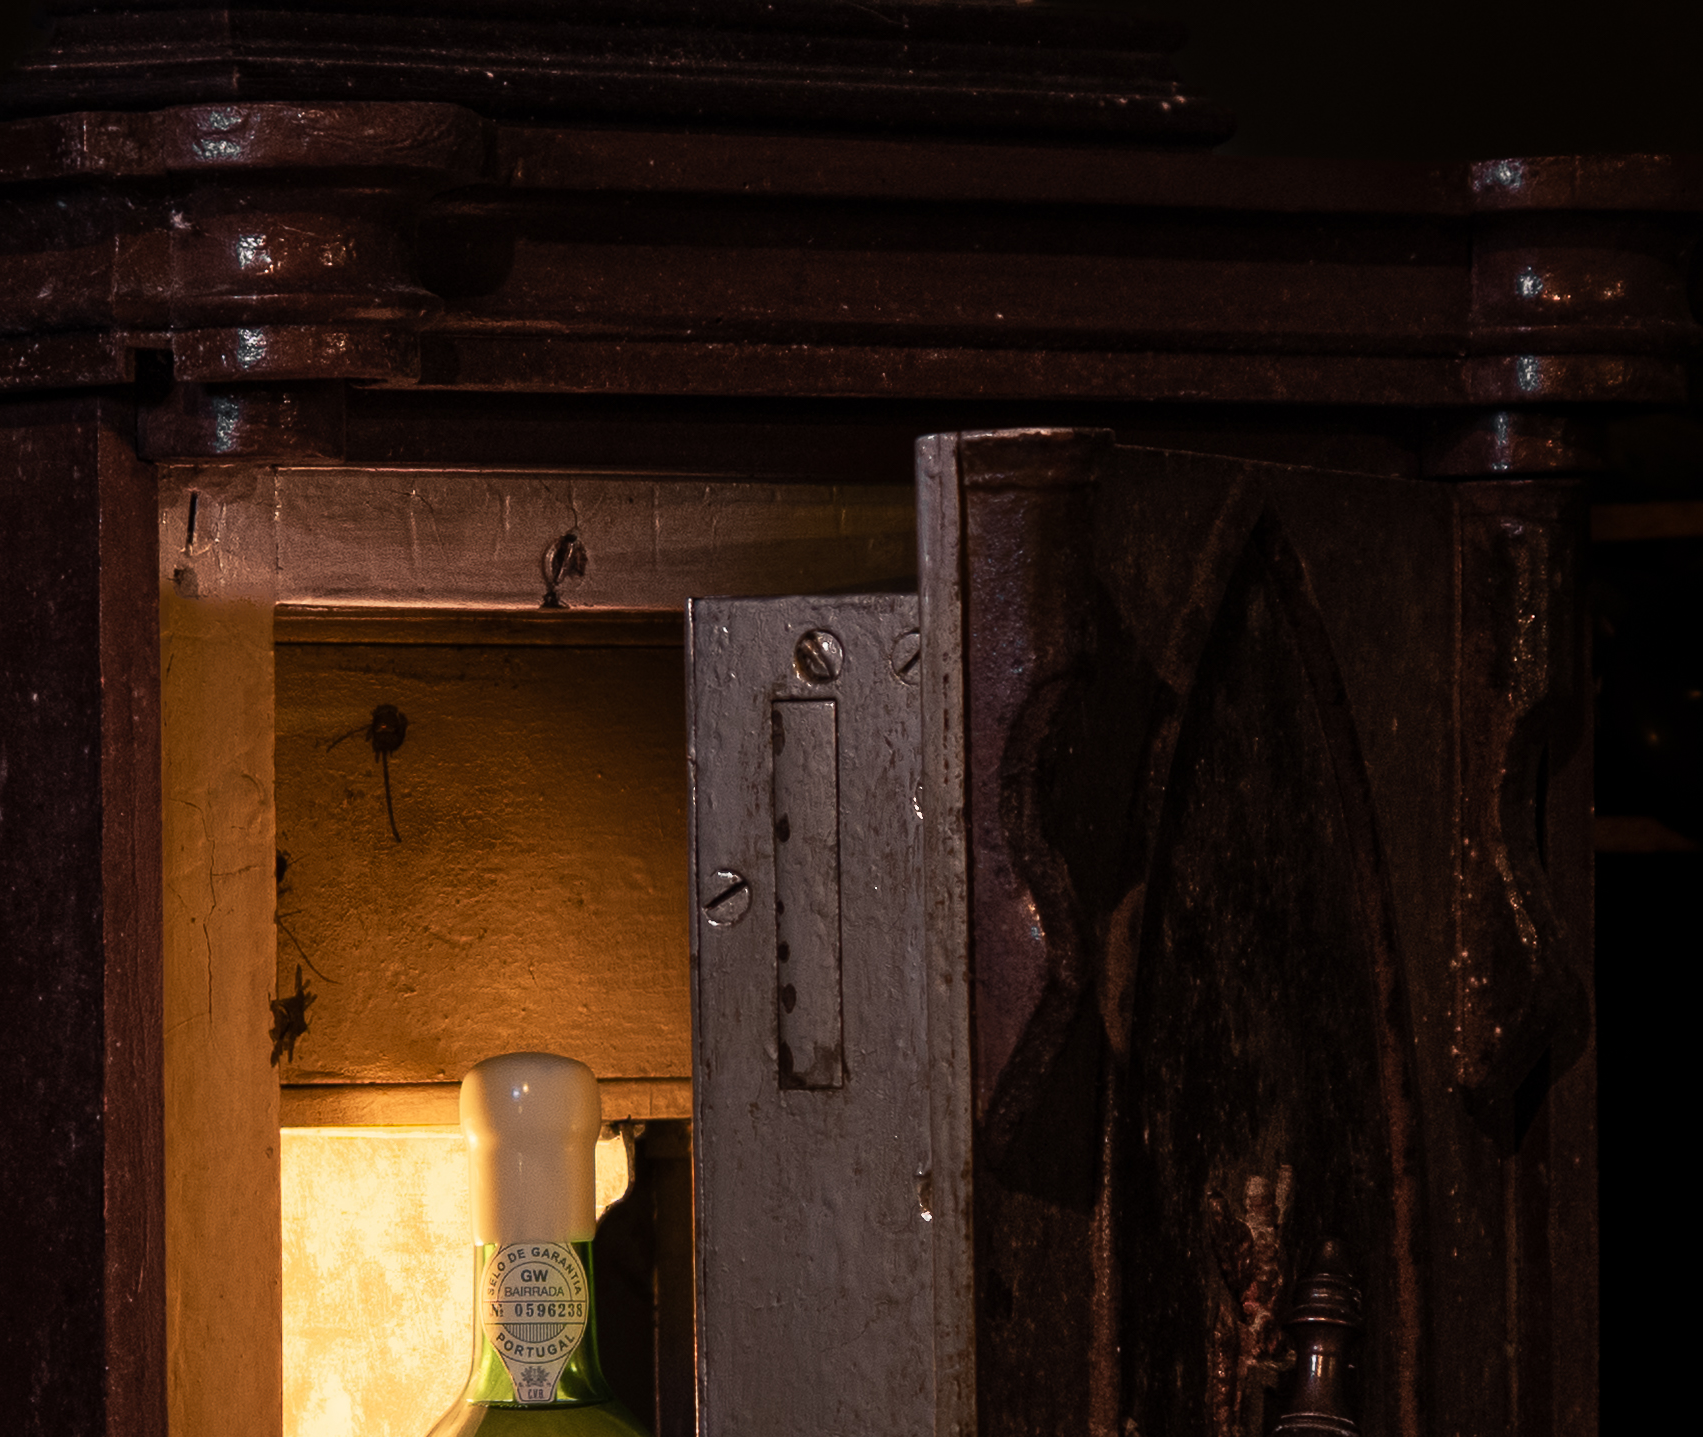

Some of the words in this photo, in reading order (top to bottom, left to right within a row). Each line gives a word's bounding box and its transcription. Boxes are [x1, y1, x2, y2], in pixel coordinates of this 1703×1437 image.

[487, 1263, 506, 1296] SELO
[508, 1249, 526, 1264] DE
[531, 1247, 582, 1295] GARANTIA
[520, 1269, 548, 1282] GW
[504, 1287, 565, 1297] BAIRRADA
[515, 1303, 583, 1317] 0596238
[496, 1332, 575, 1358] PORTUGAL
